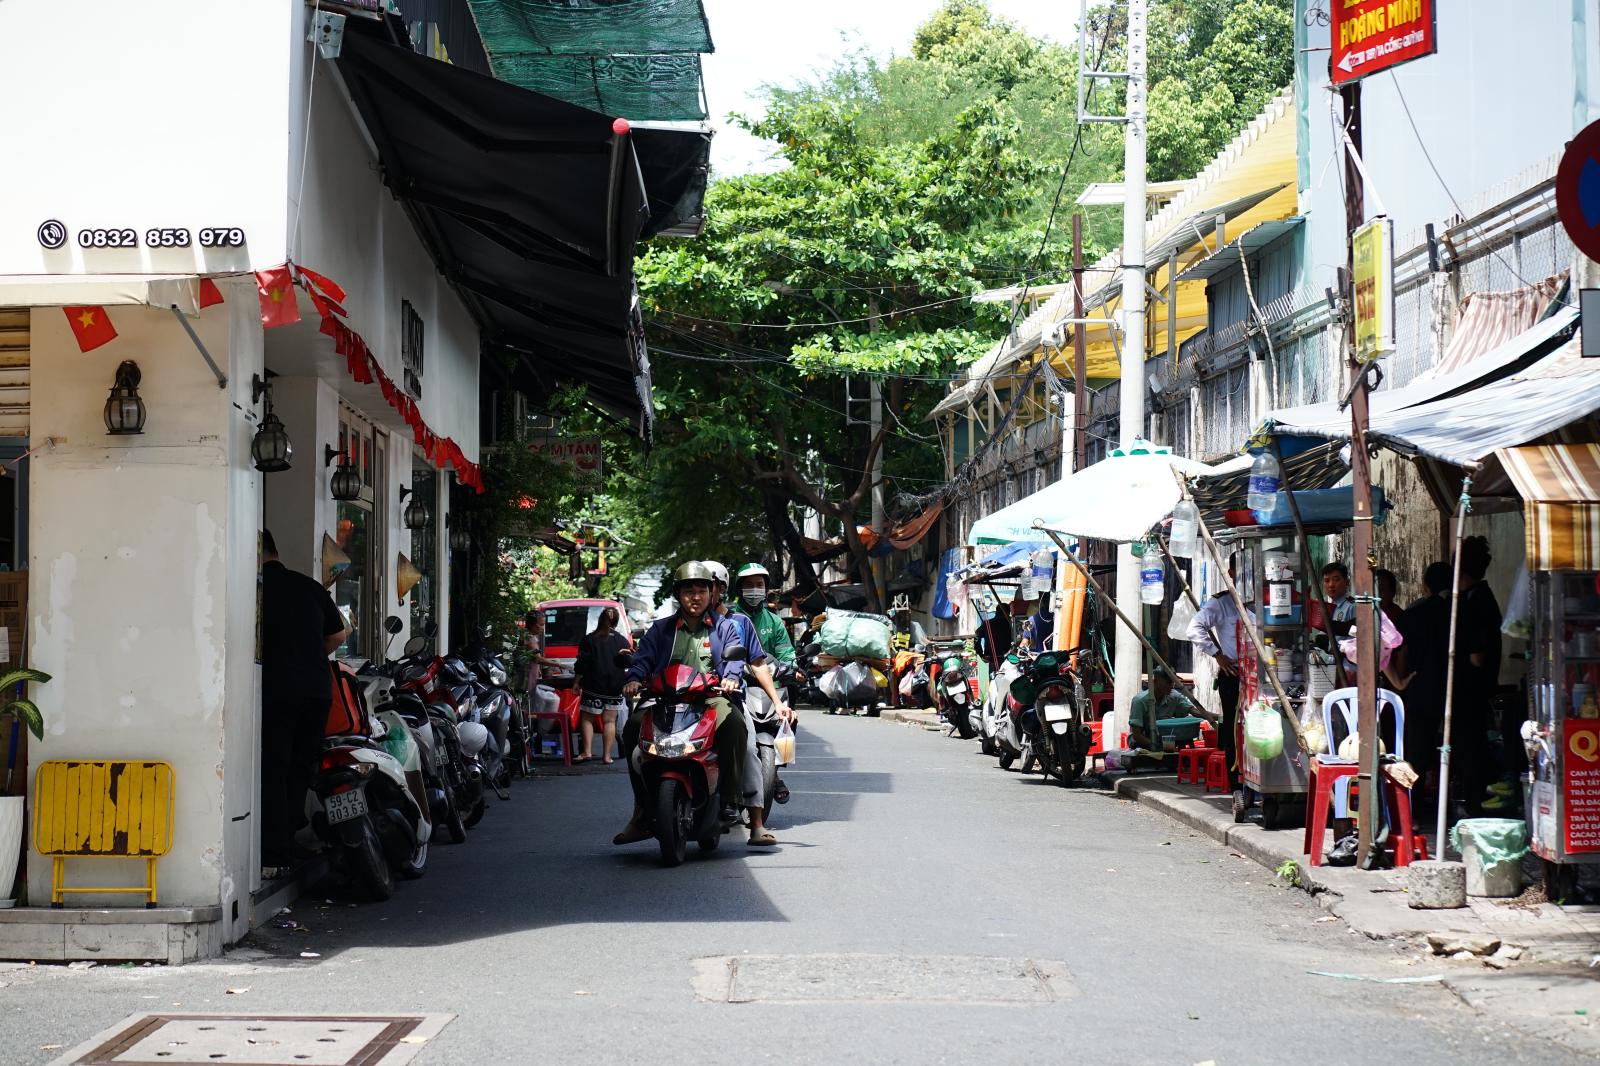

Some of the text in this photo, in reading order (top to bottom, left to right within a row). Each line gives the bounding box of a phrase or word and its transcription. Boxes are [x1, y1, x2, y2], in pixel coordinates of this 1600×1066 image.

[1340, 0, 1422, 50] HOÀNG MINH
[78, 228, 244, 248] 0832 853 979
[1570, 831, 1597, 839] CACAO
